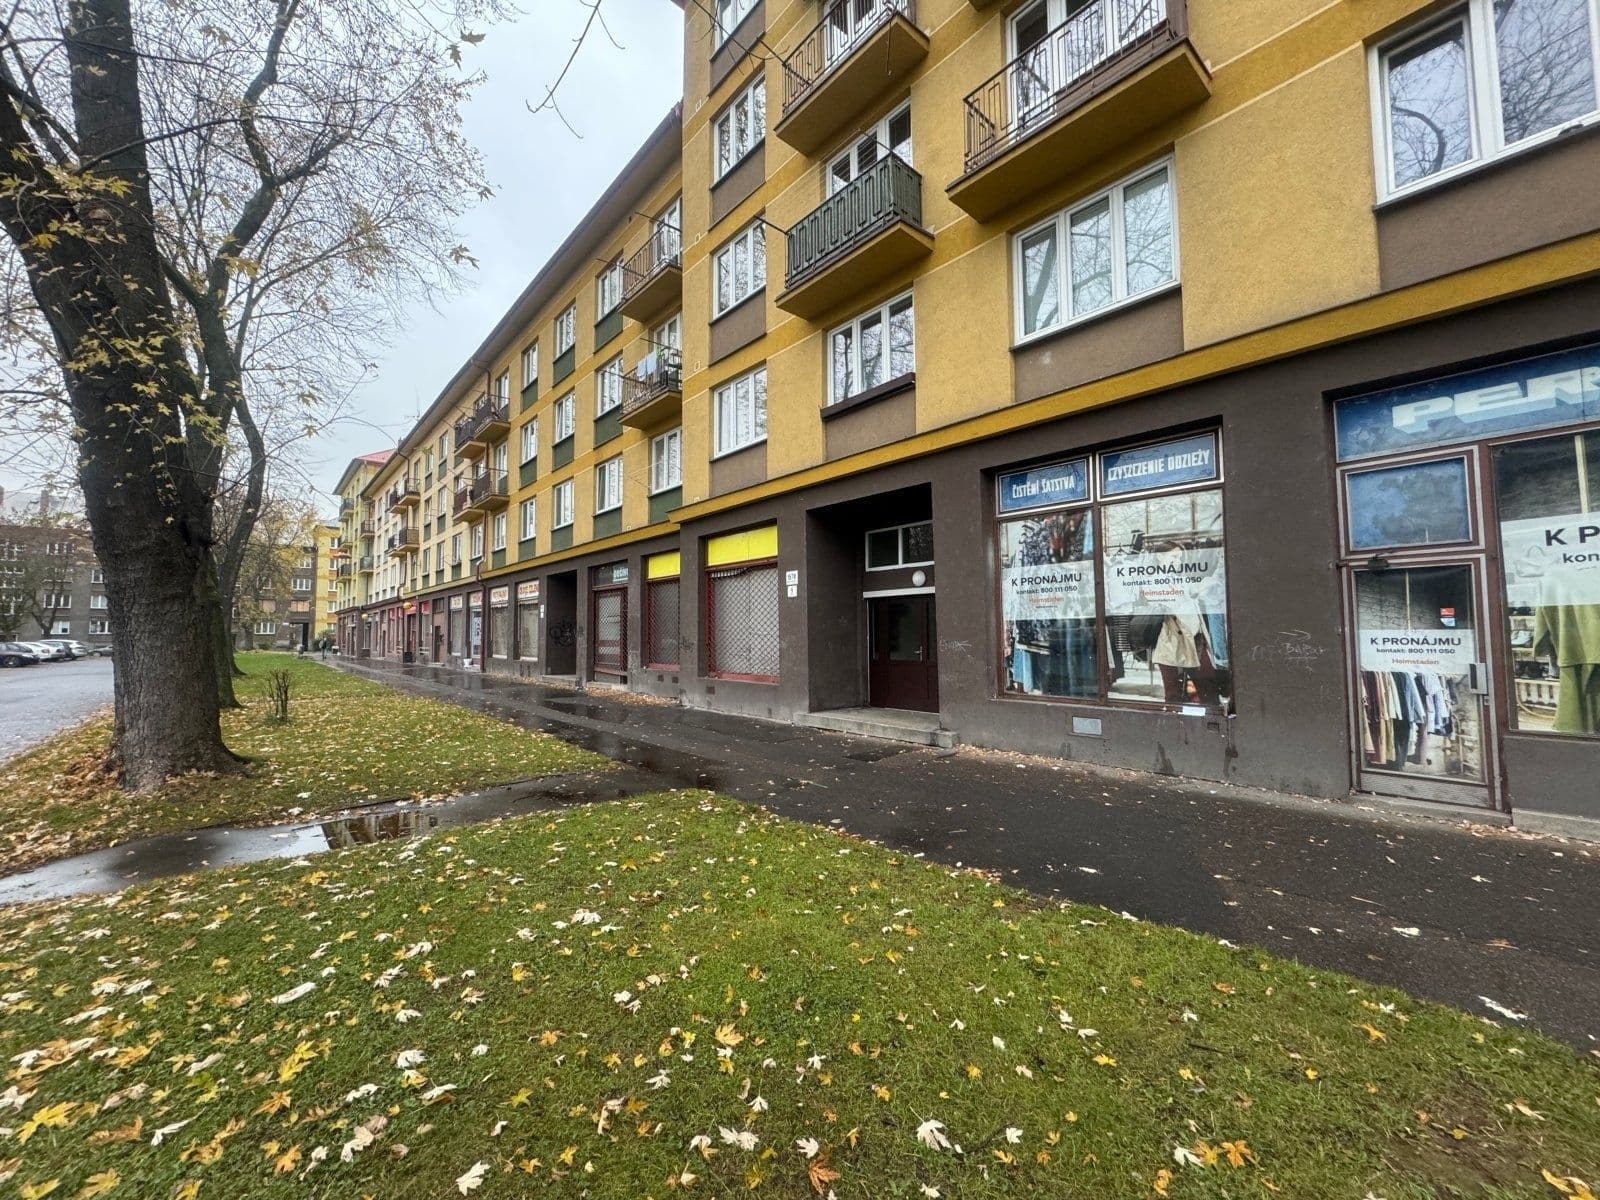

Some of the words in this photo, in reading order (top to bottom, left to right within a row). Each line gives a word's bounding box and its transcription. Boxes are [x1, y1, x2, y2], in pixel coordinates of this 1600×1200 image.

[1108, 458, 1164, 481] CZYSZCZENIE
[1167, 449, 1210, 471] ODZIEŻY
[1545, 528, 1567, 546] K
[1117, 567, 1125, 577] K
[1128, 561, 1208, 576] PRONÁJMU
[1011, 578, 1018, 587] K
[1173, 577, 1183, 585] 111
[1185, 576, 1202, 584] 050
[1370, 637, 1379, 646] K
[1382, 635, 1461, 646] PRONÁJMU
